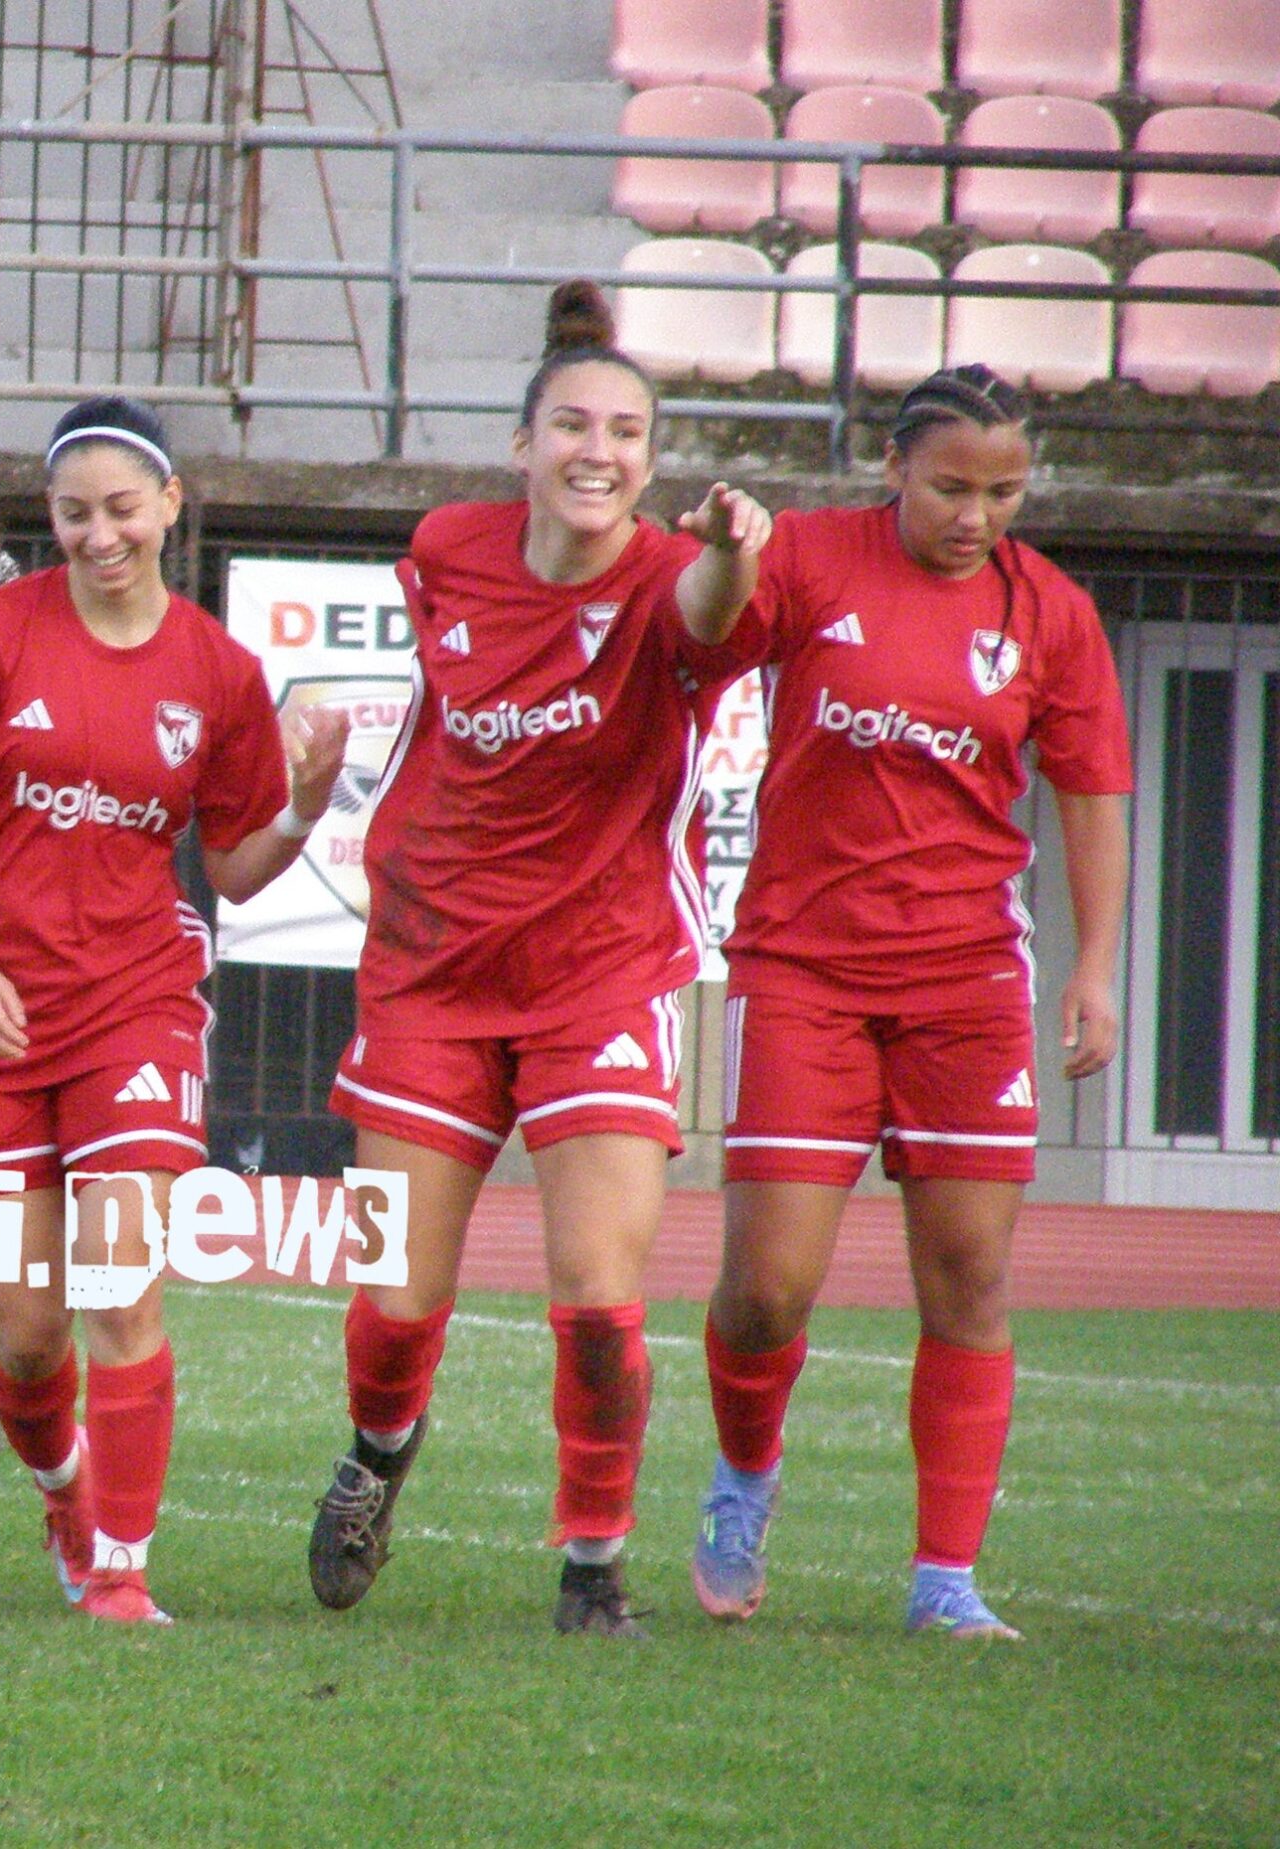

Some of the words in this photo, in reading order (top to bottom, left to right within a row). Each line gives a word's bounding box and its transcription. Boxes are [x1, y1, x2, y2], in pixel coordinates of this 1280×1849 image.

[440, 687, 601, 753] logitech
[815, 687, 982, 764] logitech
[14, 771, 169, 832] logitech
